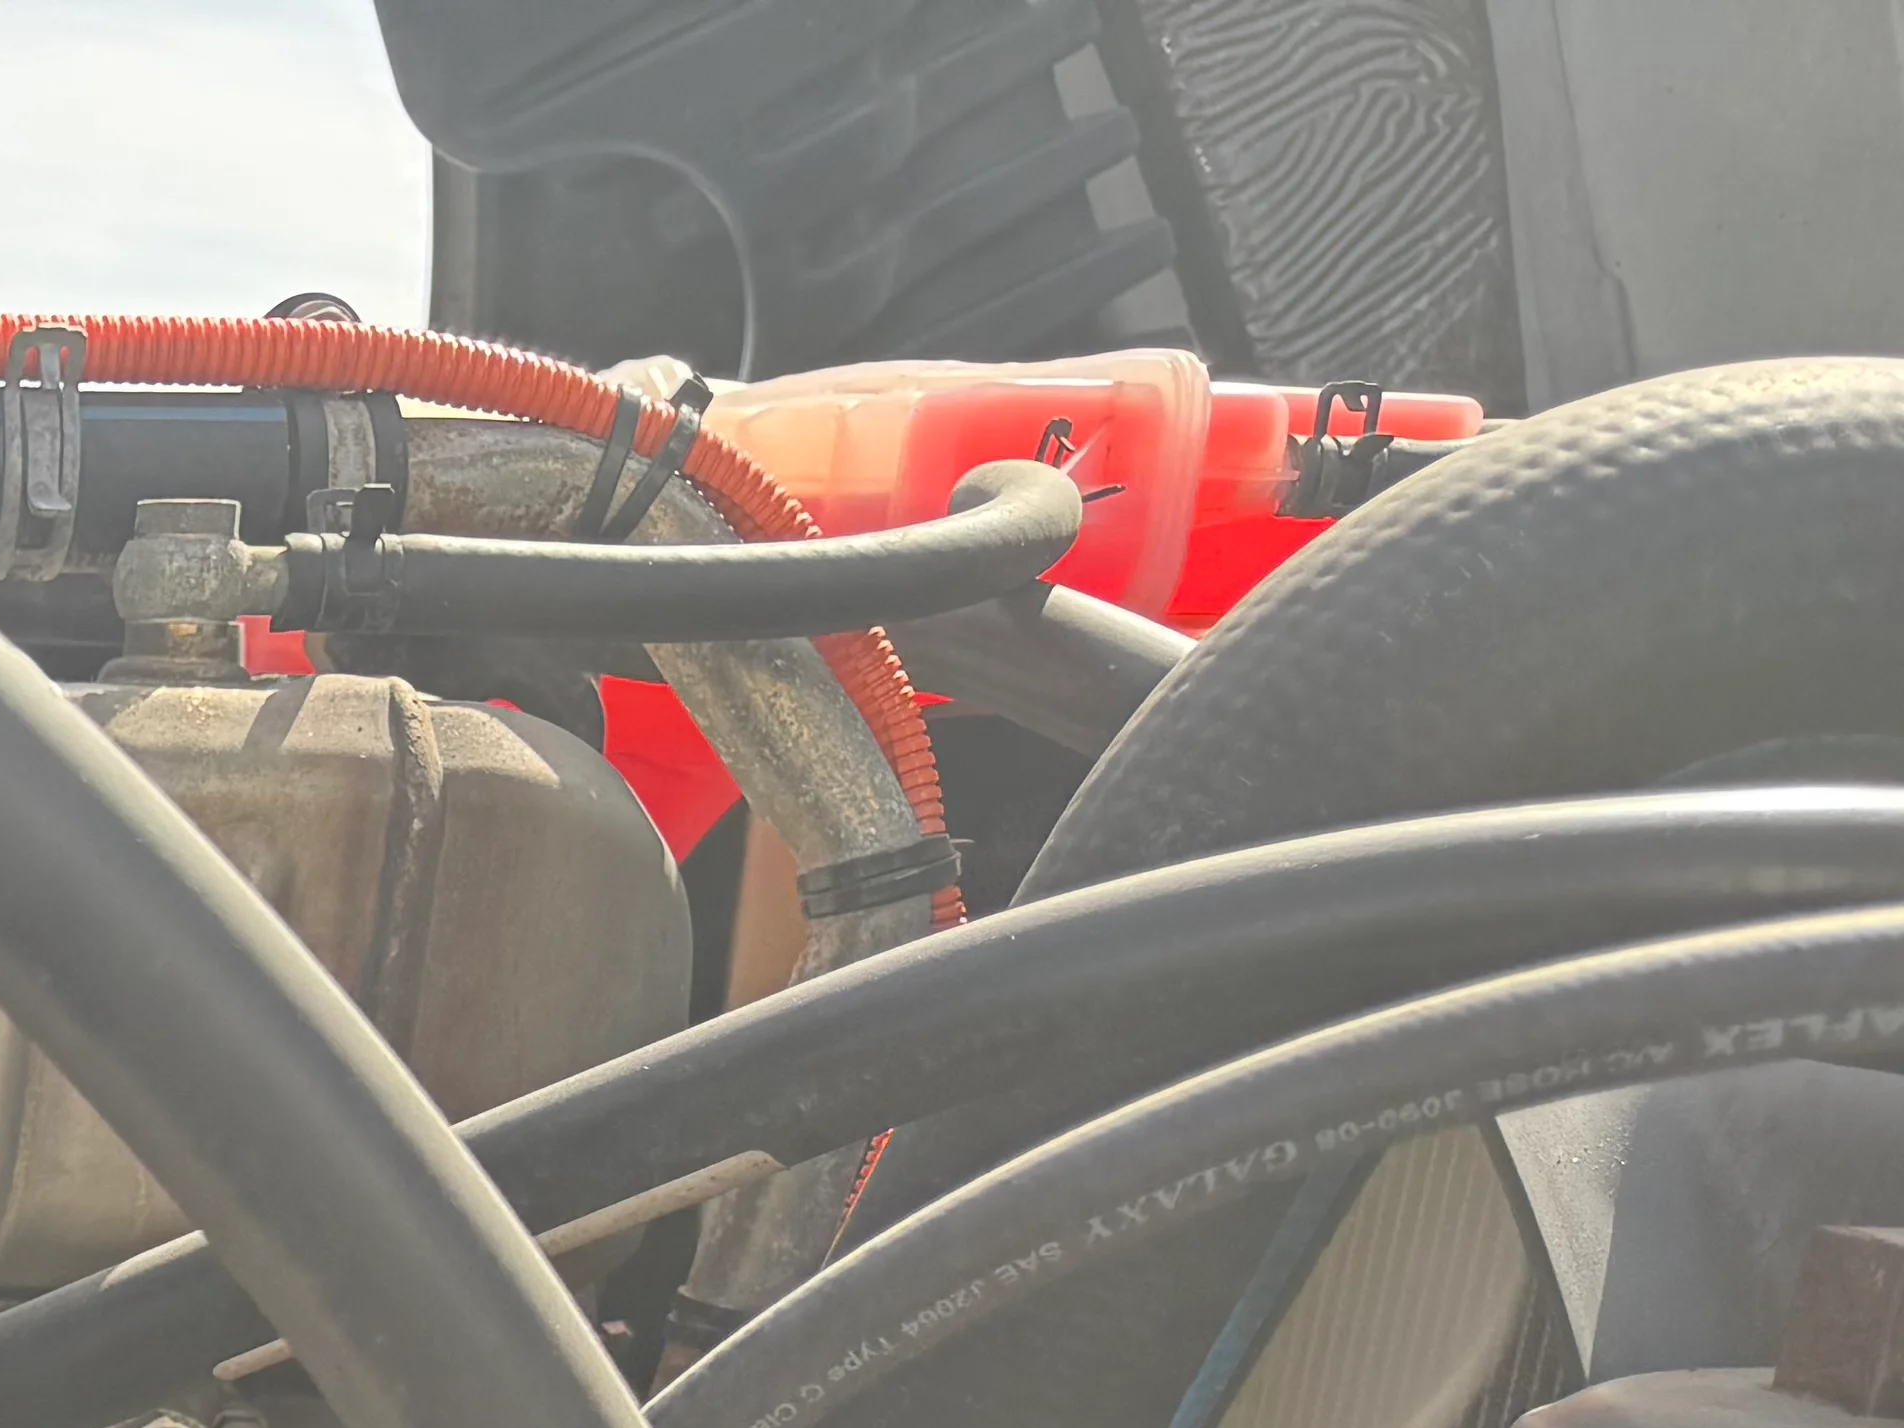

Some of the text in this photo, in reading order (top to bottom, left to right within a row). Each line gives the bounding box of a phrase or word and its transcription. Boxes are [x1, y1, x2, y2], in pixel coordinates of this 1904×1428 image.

[1701, 1006, 1904, 1058] AFLEX
[1087, 1141, 1298, 1244] GALAXY
[994, 1241, 1063, 1284] SAE
[828, 1336, 896, 1382] Type
